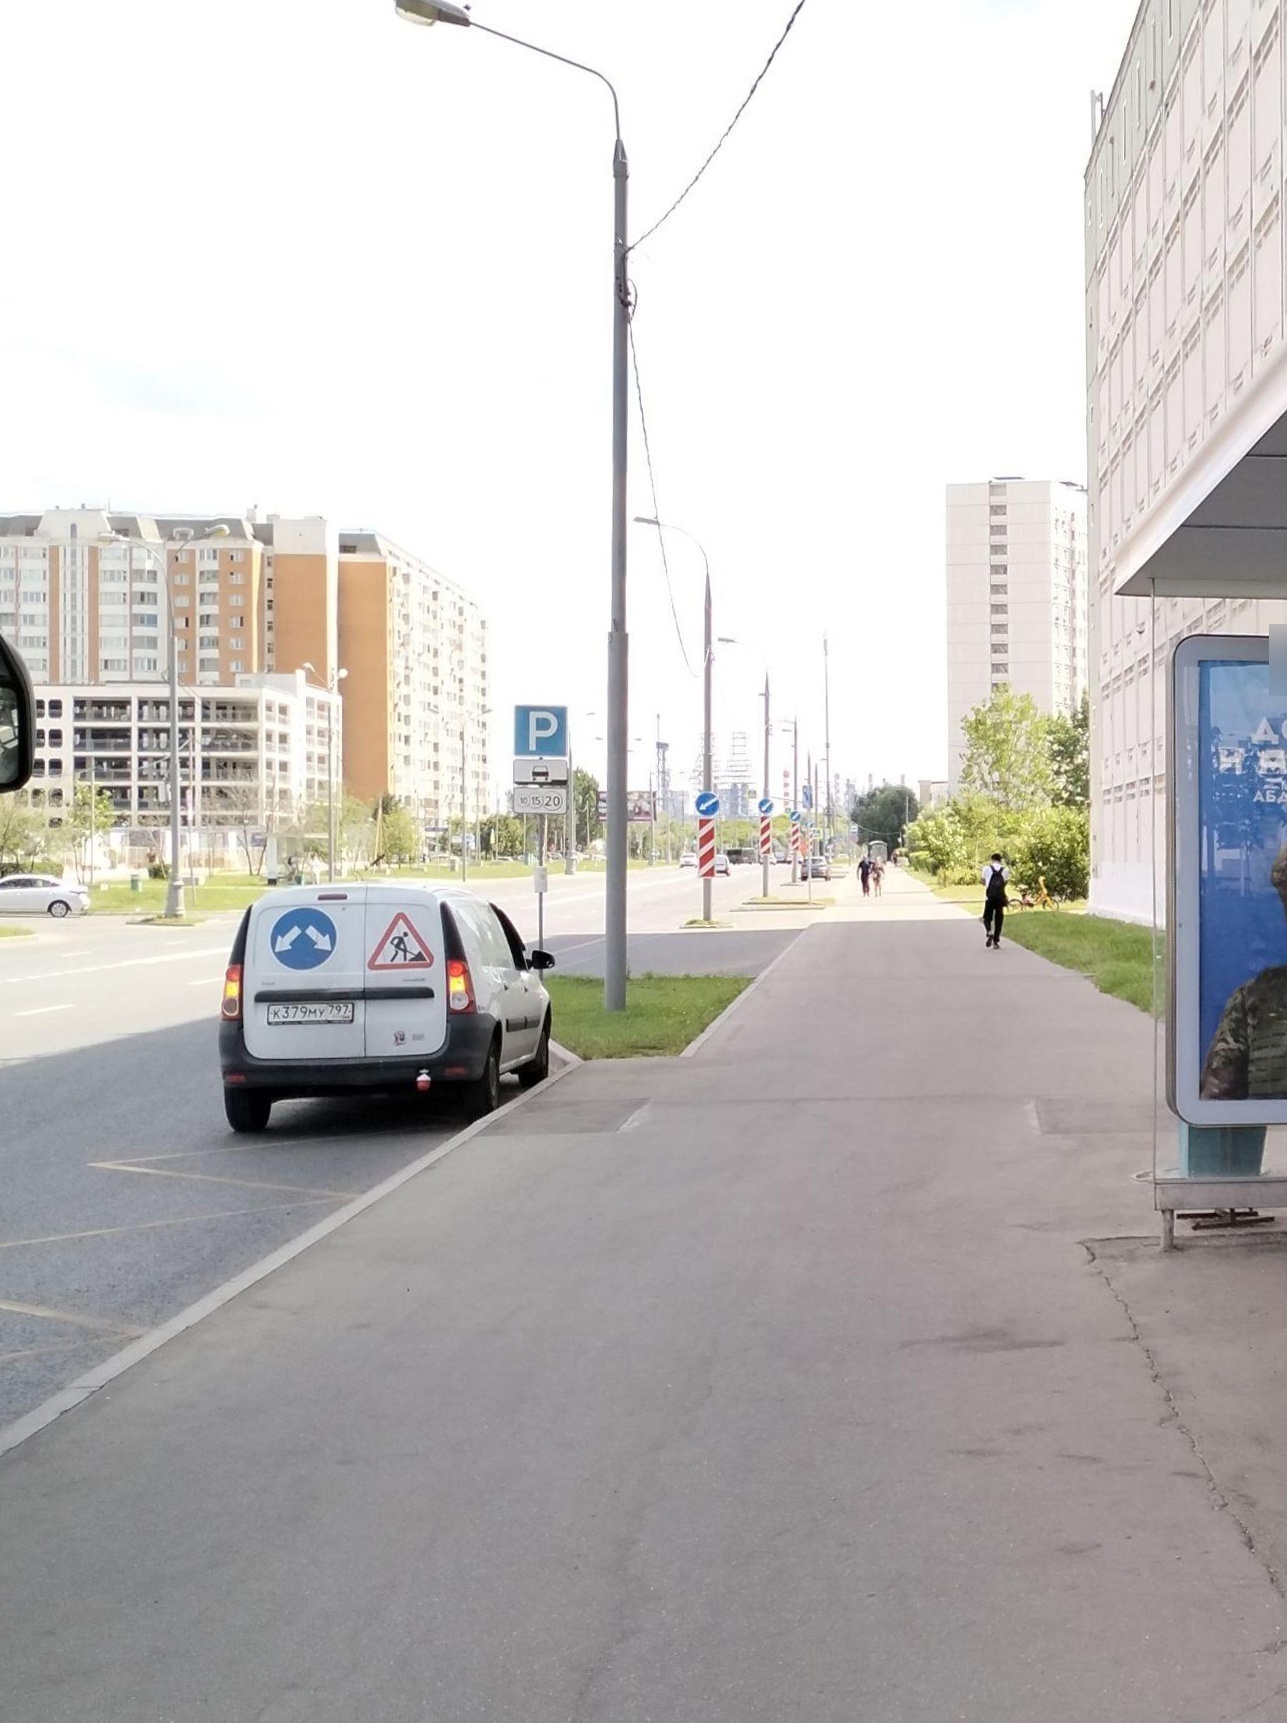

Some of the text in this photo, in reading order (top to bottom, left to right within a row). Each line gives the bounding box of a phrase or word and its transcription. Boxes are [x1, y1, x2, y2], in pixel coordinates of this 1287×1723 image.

[528, 710, 558, 751] P
[531, 796, 541, 806] 15
[545, 795, 561, 807] 20
